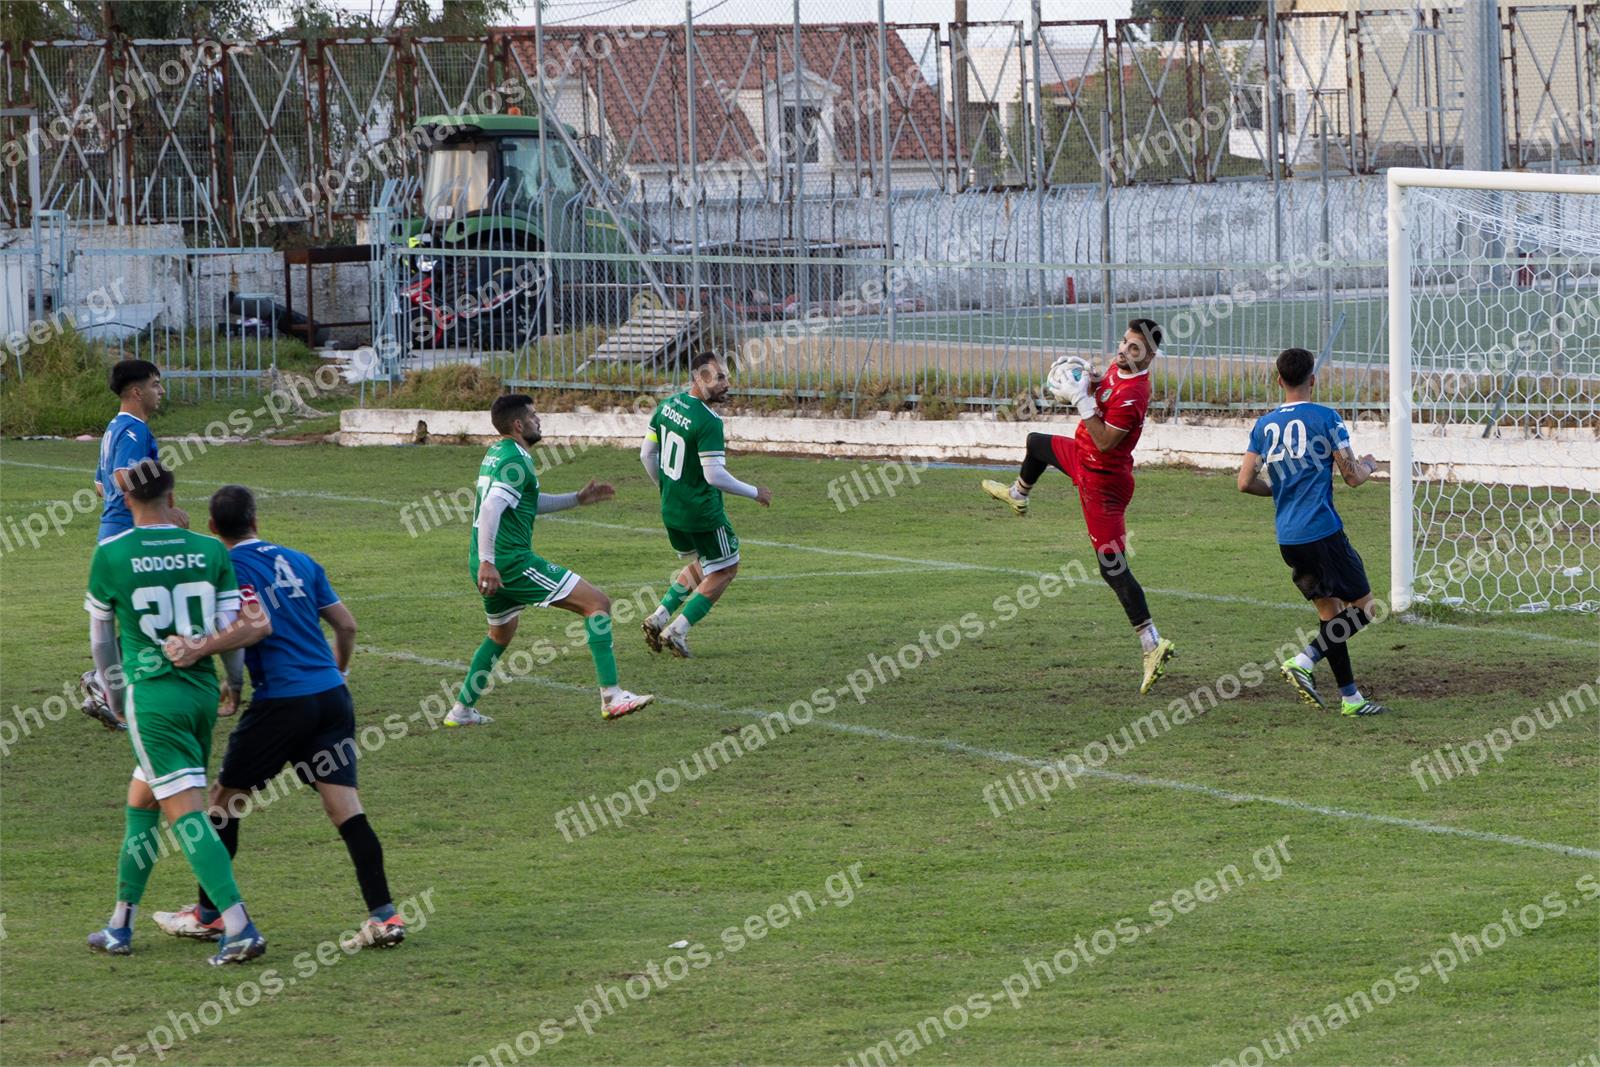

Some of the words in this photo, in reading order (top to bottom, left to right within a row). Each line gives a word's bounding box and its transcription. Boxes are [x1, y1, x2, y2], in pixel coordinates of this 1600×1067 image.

[659, 424, 686, 481] 10
[1263, 419, 1307, 464] 20
[130, 555, 185, 573] RODOS
[187, 553, 206, 569] FC
[274, 554, 307, 599] 4
[131, 581, 217, 646] 20
